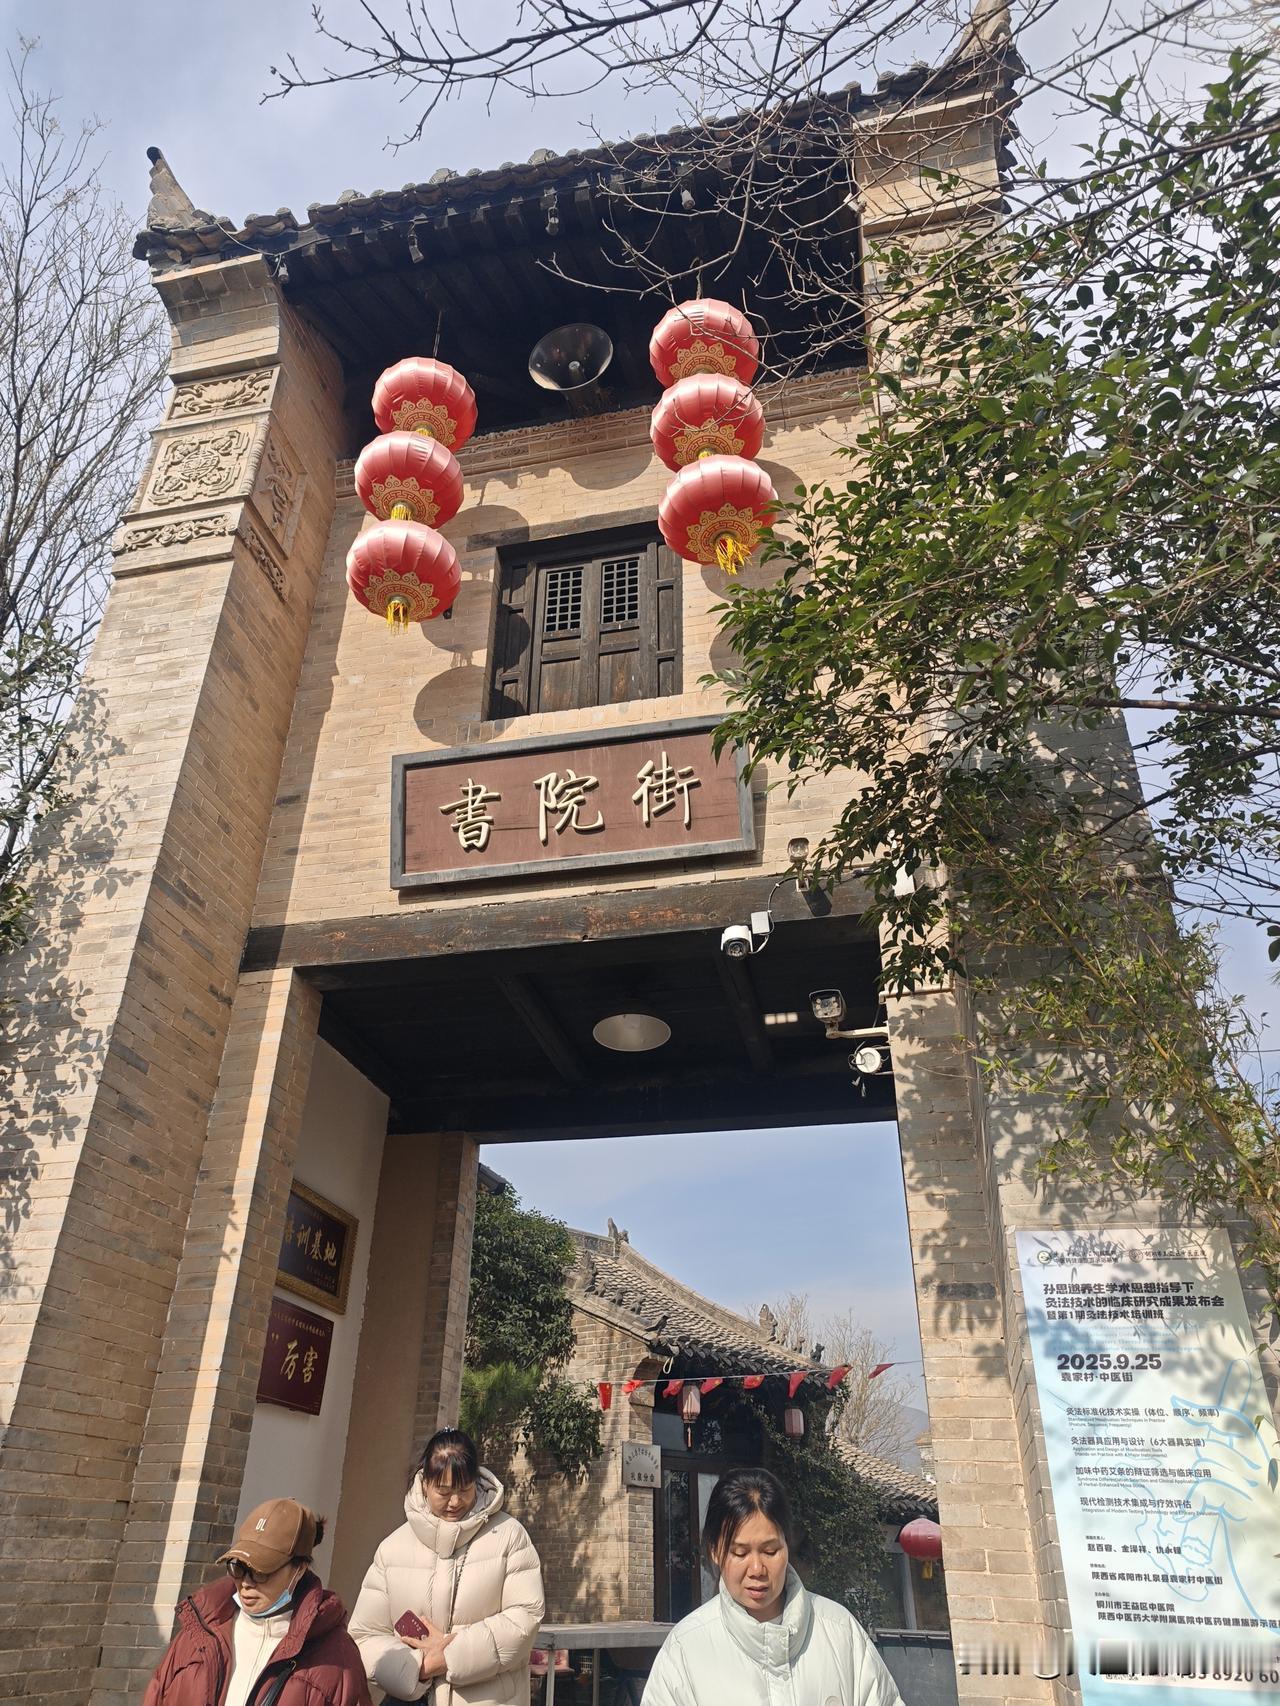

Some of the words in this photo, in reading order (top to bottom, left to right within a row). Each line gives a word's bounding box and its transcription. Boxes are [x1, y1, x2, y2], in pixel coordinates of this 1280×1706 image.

[438, 751, 701, 851] 書院街
[1043, 1282, 1195, 1295] 孙思邈养生学术思想指导下
[1045, 1295, 1225, 1308] 灸法技术的临床研究成果发布会
[1047, 1309, 1164, 1320] 暨第1期灸法技术培训班
[1057, 1354, 1162, 1370] 2025.9.25
[1098, 1612, 1280, 1628] 陕西中医药大学附属医院中医药健康旅游示范
